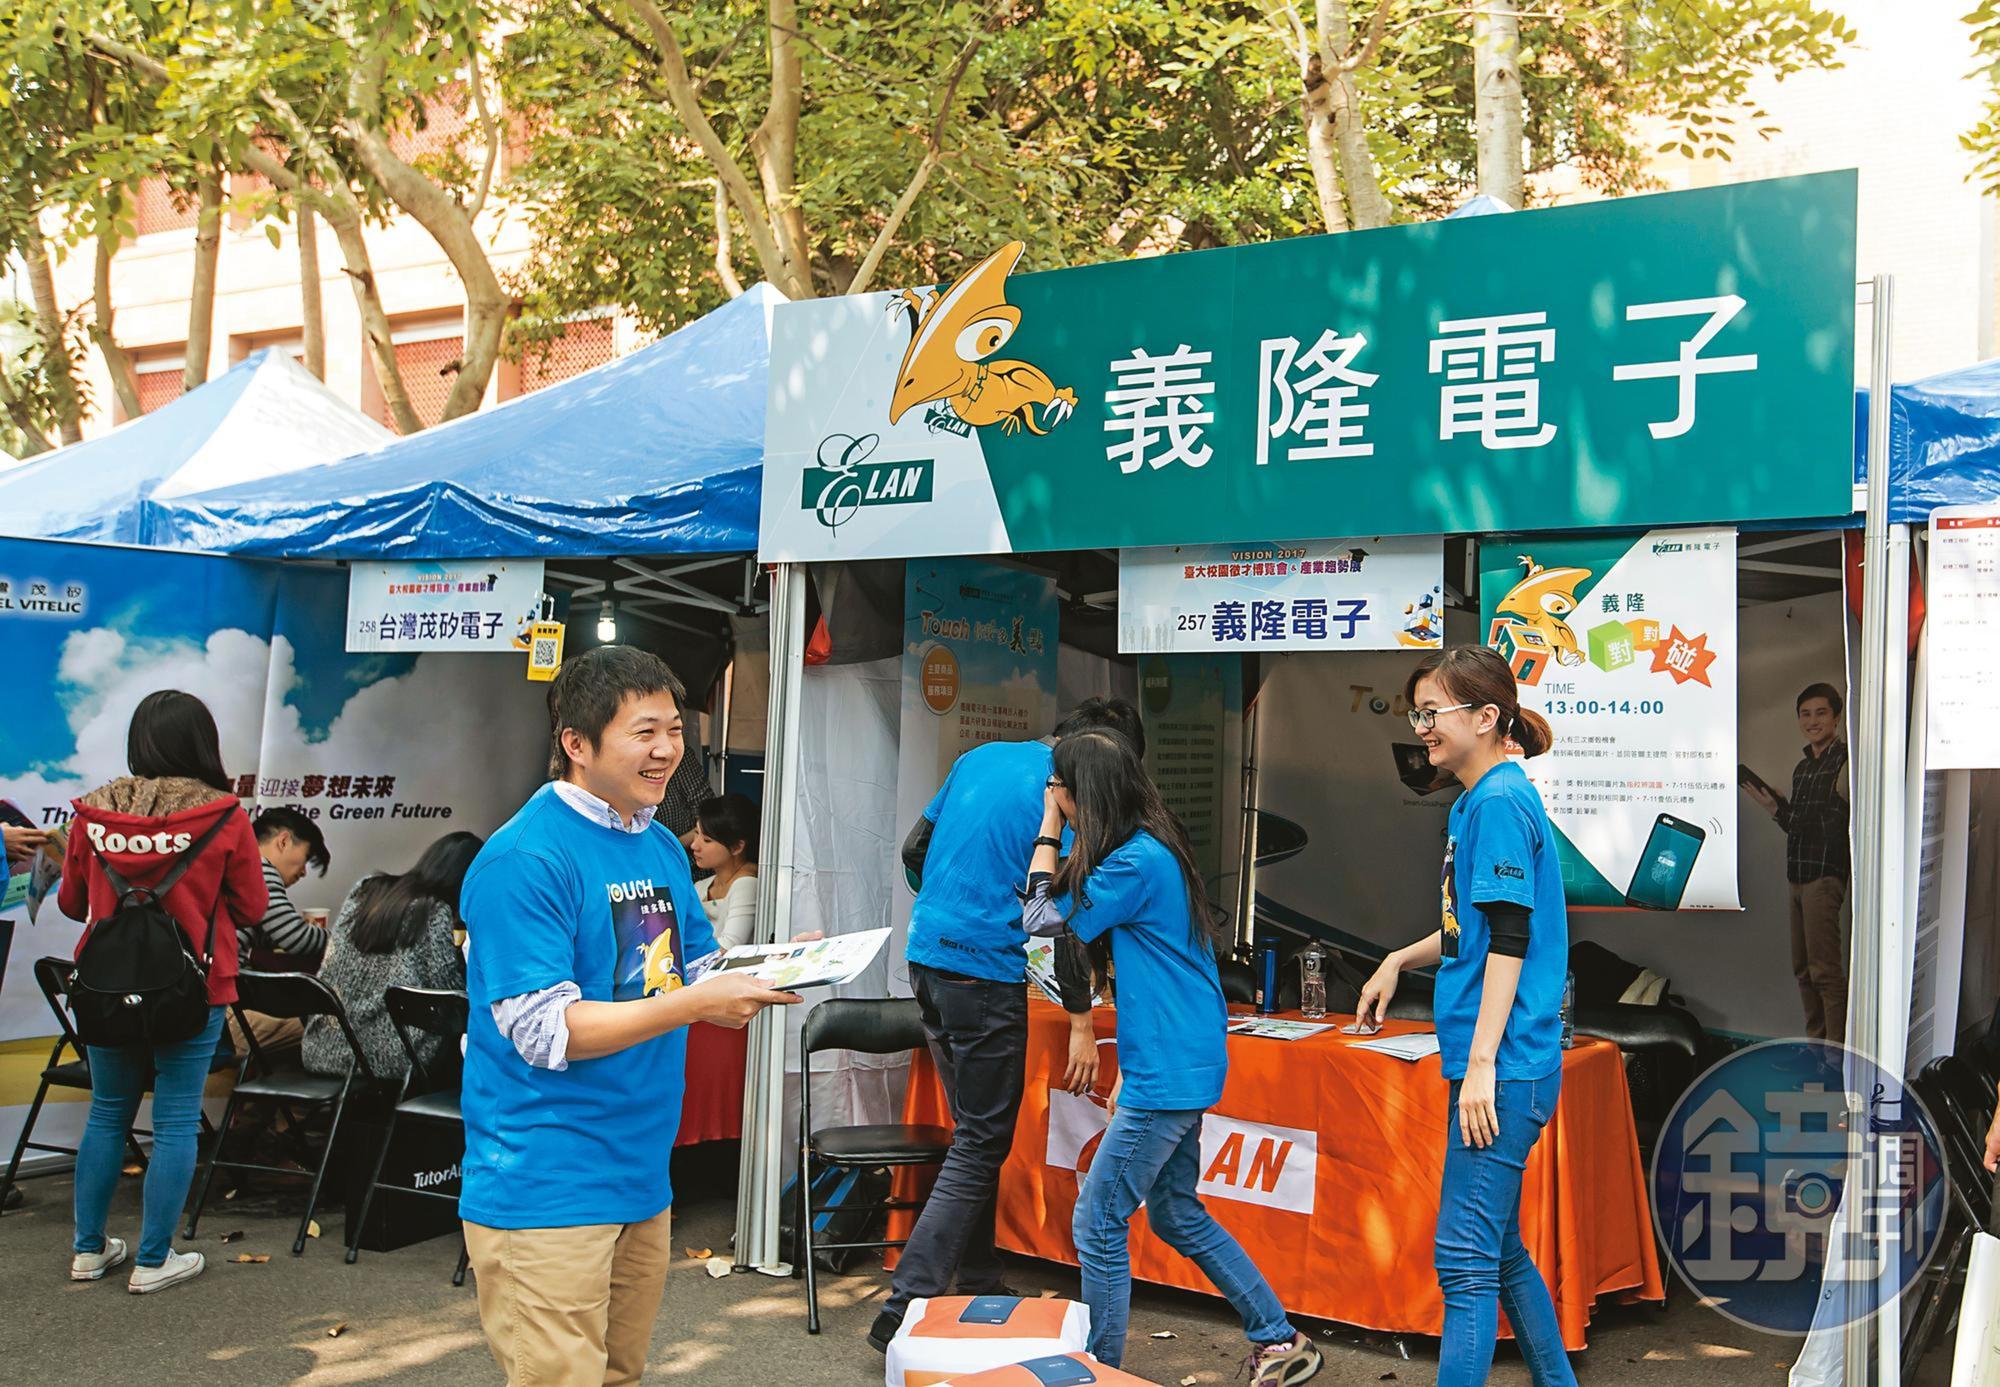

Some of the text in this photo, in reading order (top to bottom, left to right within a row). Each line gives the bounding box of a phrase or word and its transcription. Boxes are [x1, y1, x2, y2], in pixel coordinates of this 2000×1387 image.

[1103, 295, 1758, 474] 義隆電子
[816, 433, 924, 538] ELAN
[1231, 549, 1307, 561] VISION 2017
[19, 599, 81, 613] VITELIC
[1602, 592, 1645, 613] 義隆
[359, 612, 504, 641] 258 台灣茂矽電子
[921, 609, 970, 641] Touch
[1177, 598, 1370, 642] 257 義隆電子
[1544, 683, 1575, 694] TIME
[1544, 701, 1664, 714] 13:00-14:00
[329, 804, 384, 820] Green
[391, 803, 453, 819] Future
[86, 821, 192, 855] Roots
